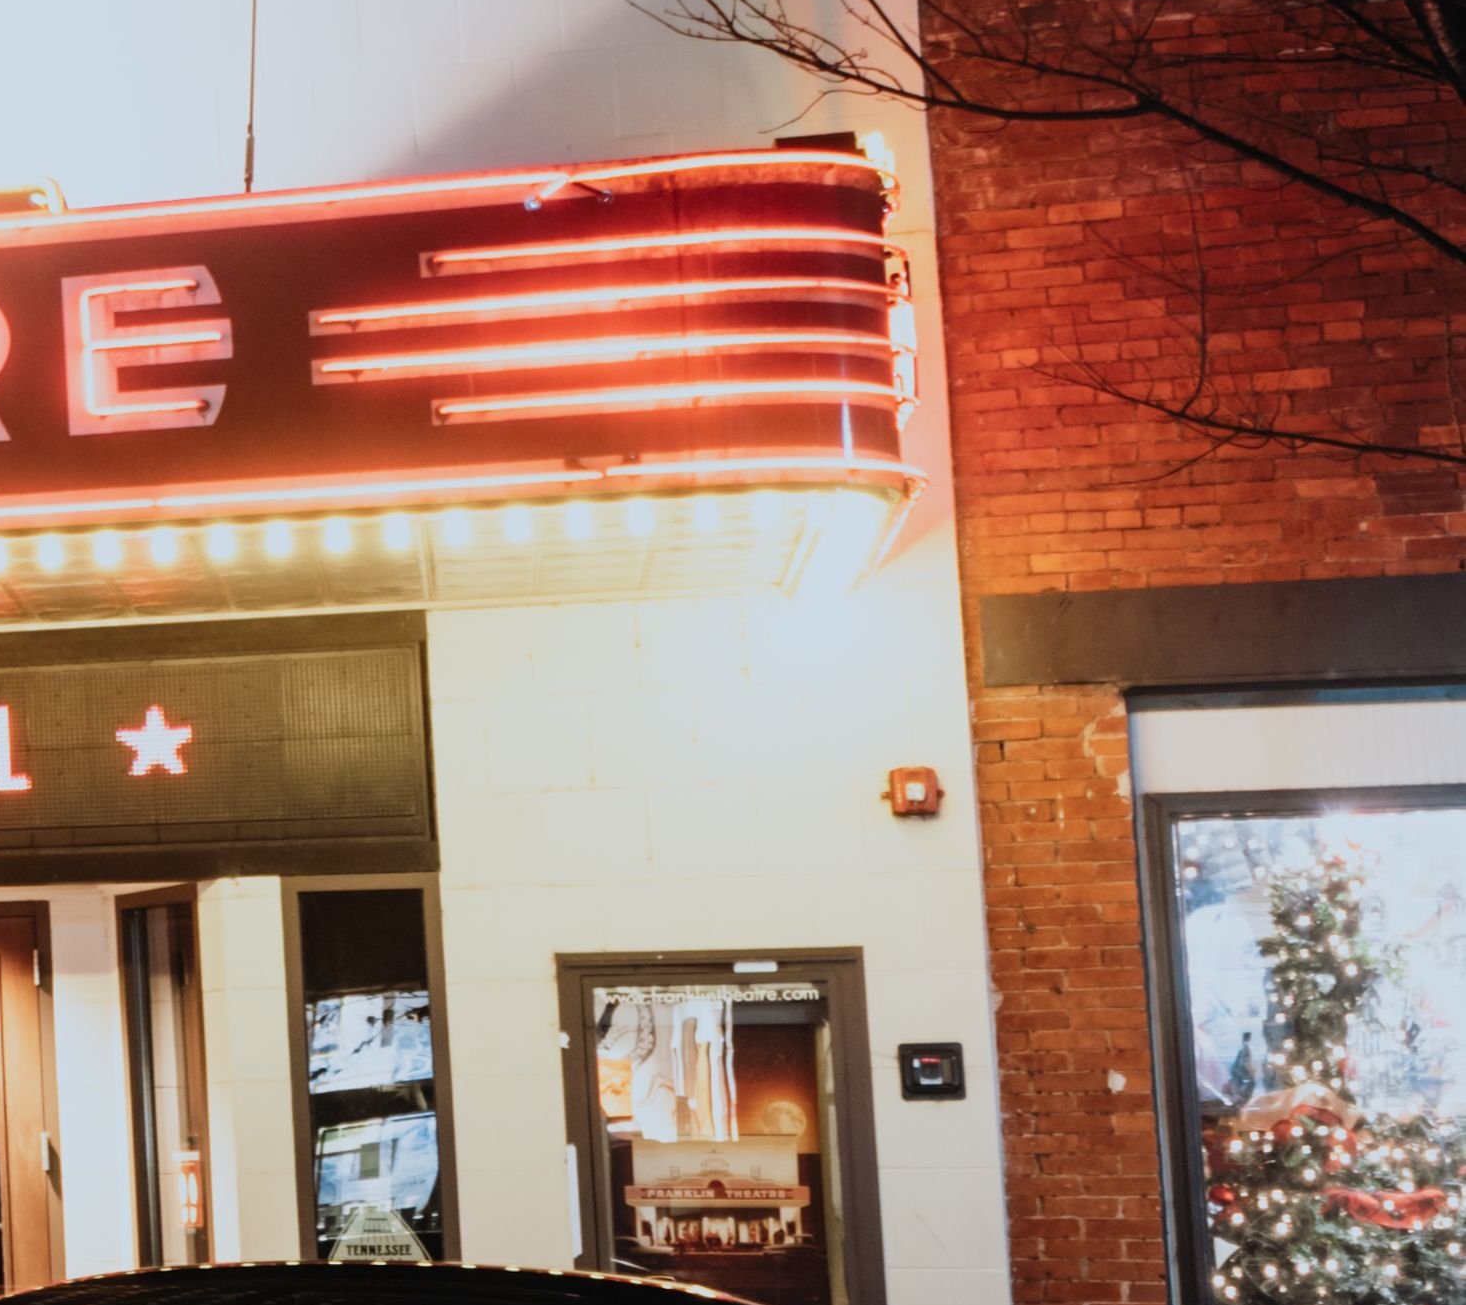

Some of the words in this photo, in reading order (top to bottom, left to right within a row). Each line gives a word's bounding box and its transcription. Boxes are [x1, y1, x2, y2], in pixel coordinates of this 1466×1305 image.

[647, 1189, 715, 1199] FRANKLIN
[724, 1189, 786, 1199] THEATRE
[346, 1245, 413, 1256] TENNESSEE
